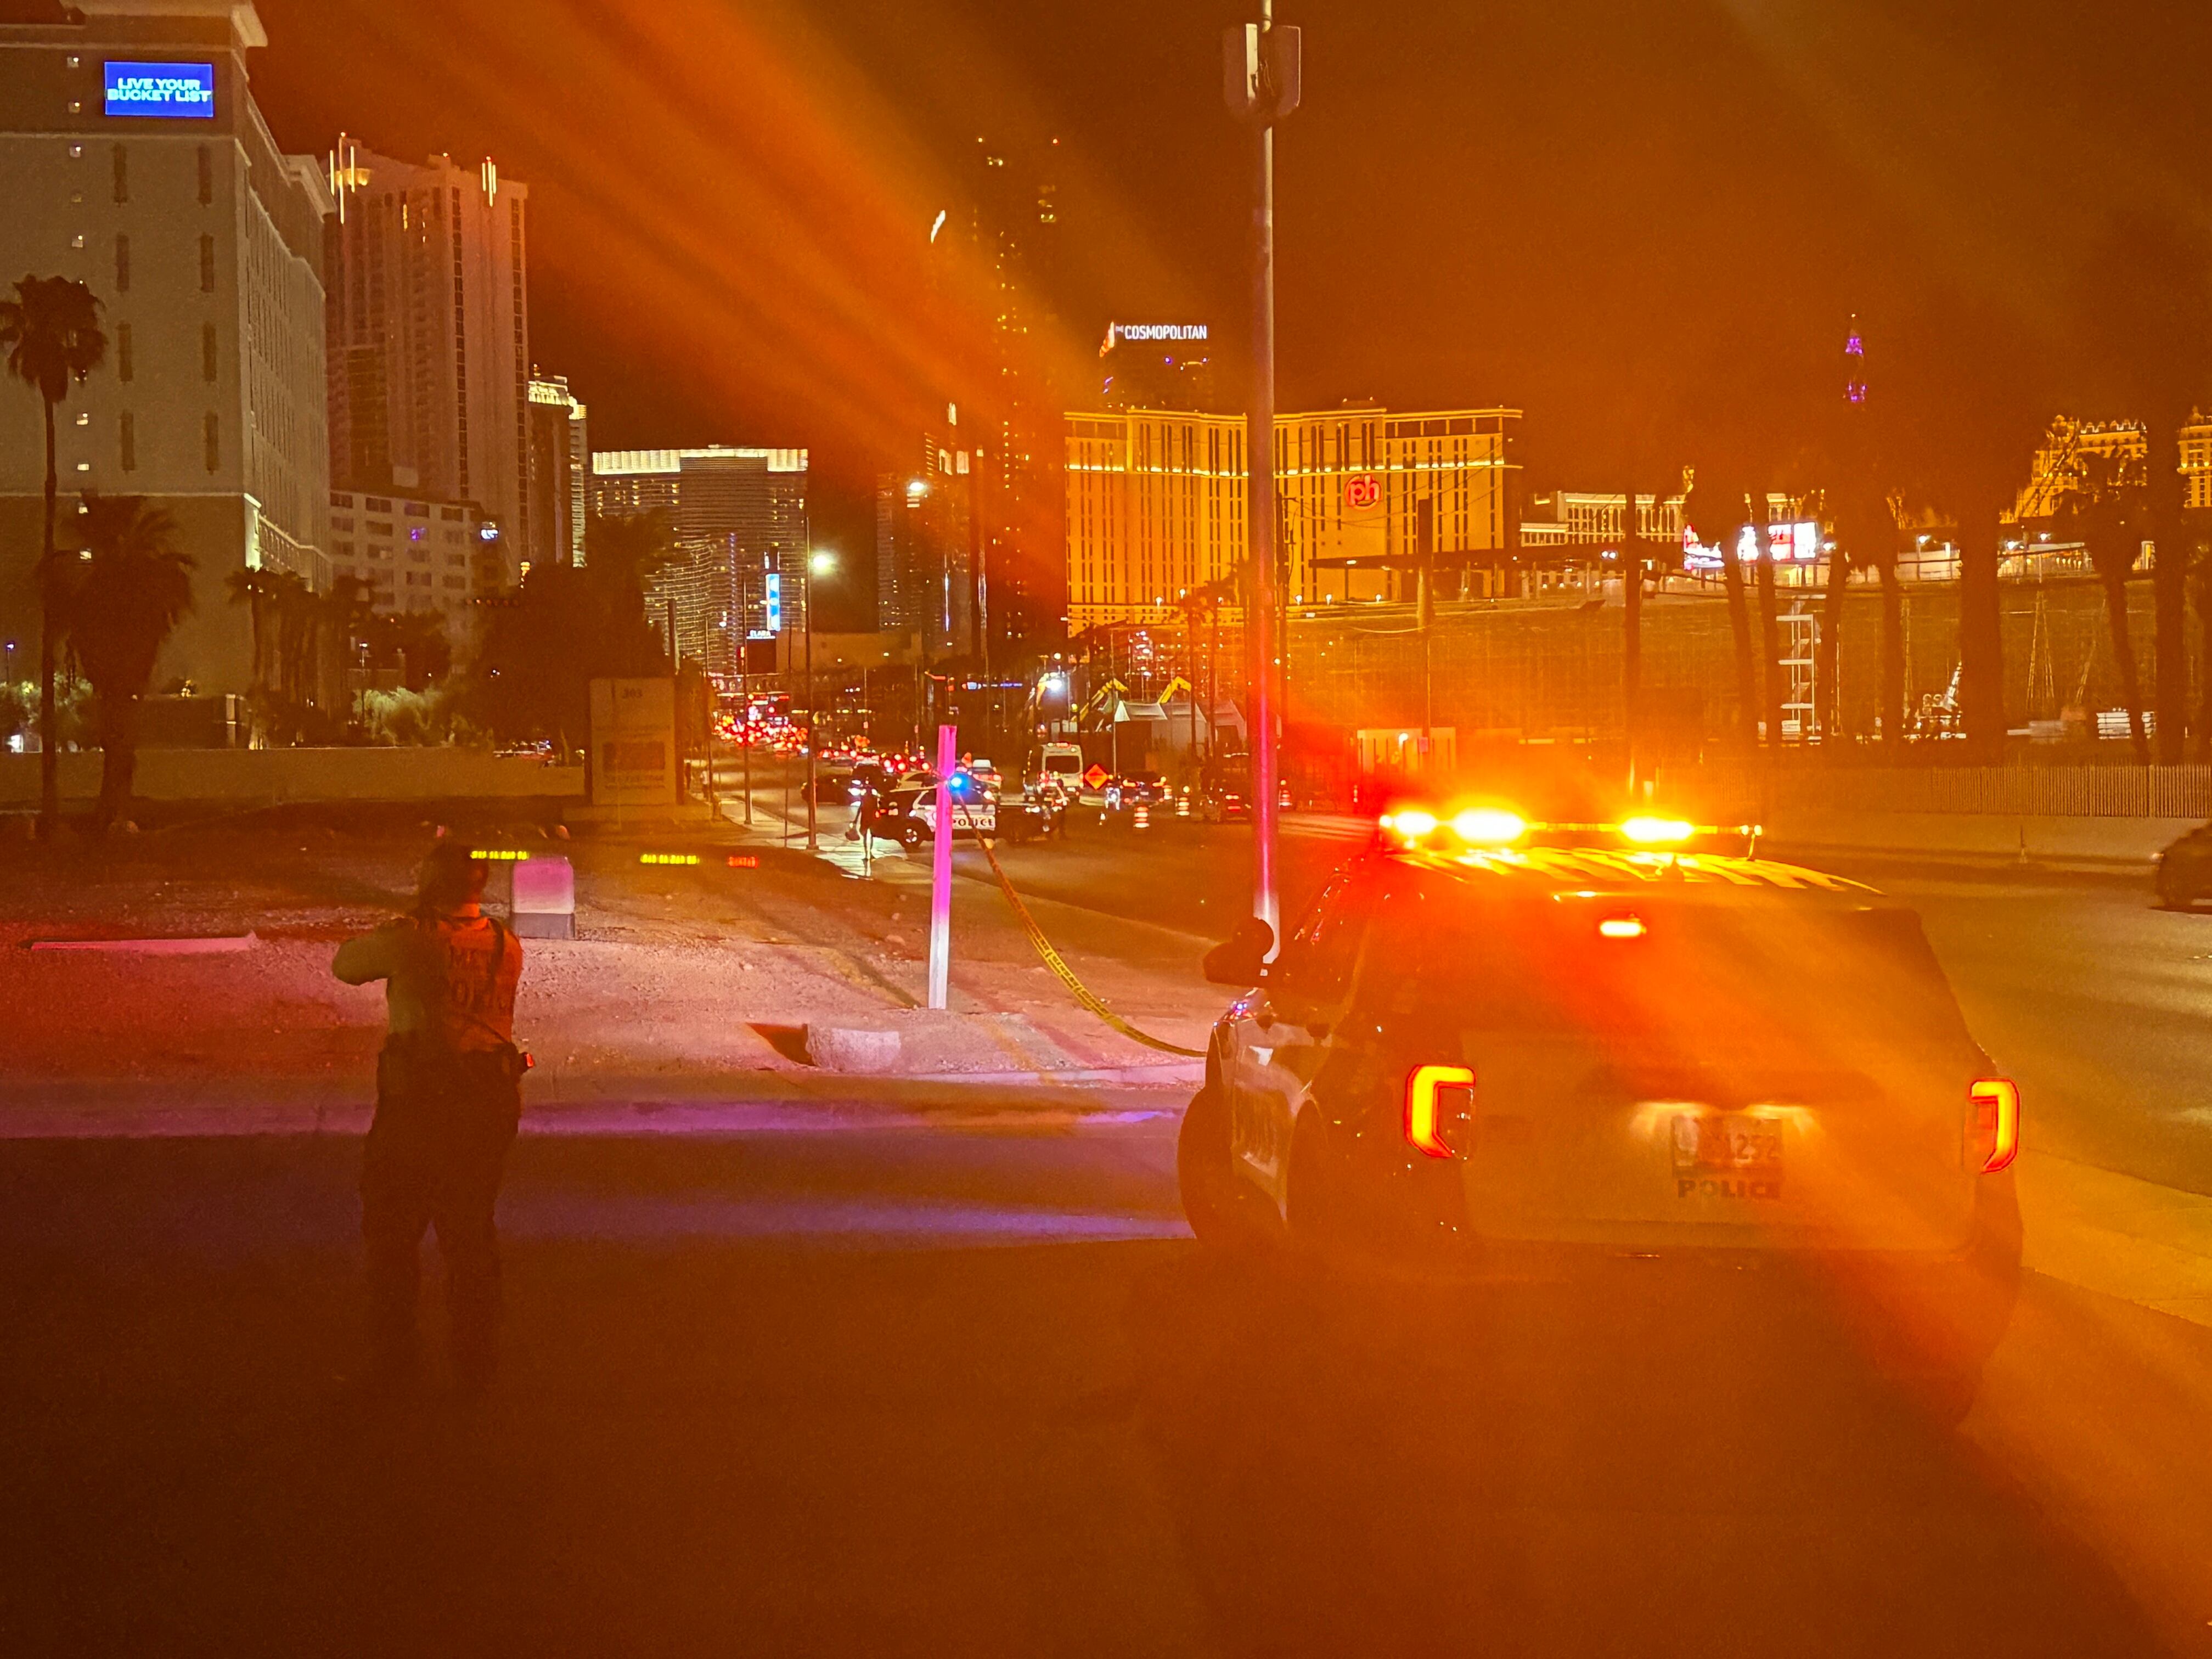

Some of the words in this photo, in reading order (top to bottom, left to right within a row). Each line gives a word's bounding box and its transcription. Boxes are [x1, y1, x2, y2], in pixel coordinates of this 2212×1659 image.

[117, 77, 154, 89] LIVE
[155, 78, 200, 91] YOUR
[107, 89, 173, 101] BUCKET
[175, 90, 212, 102] LIST
[1125, 325, 1207, 340] COSMOPOLITAN
[1350, 475, 1380, 505] ph
